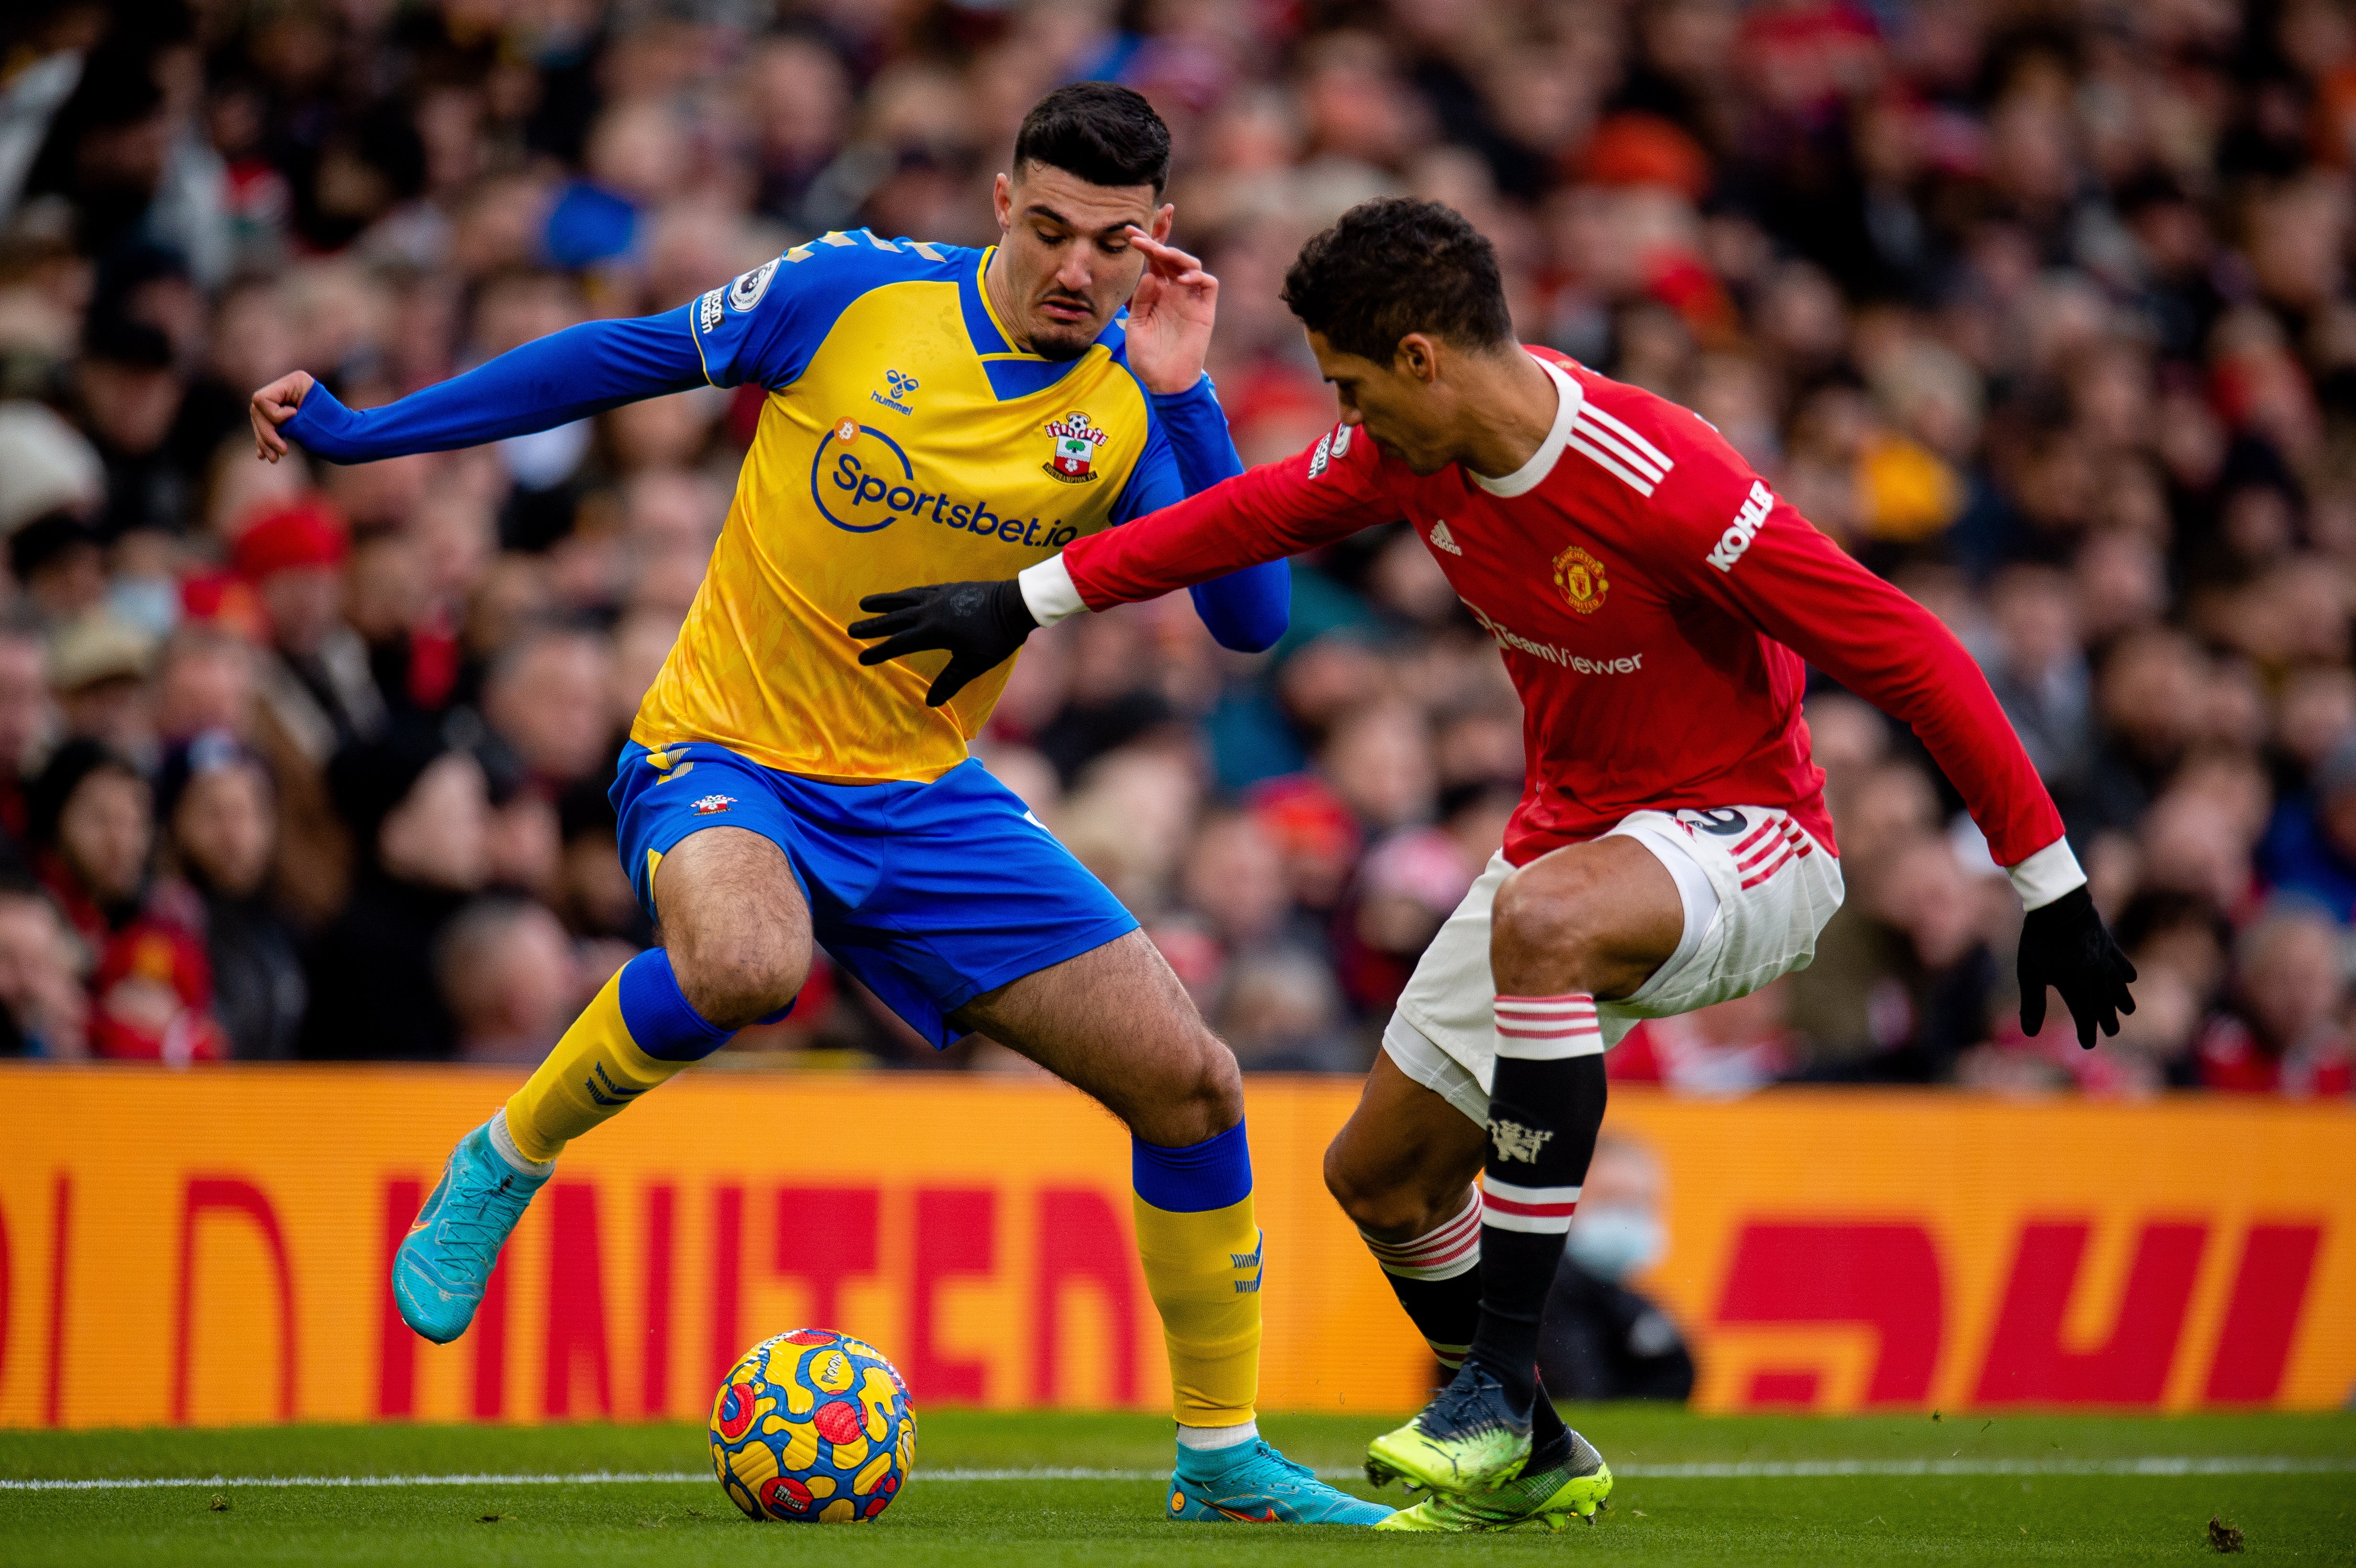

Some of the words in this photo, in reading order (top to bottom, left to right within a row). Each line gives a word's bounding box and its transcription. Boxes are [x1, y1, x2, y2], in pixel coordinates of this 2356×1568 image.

[870, 390, 914, 416] hummel
[1044, 464, 1087, 483] SOUTHAMPTON
[1087, 471, 1096, 480] FC
[832, 453, 1078, 548] Sportsbet.io
[1705, 479, 1775, 573] KOHLER
[1429, 534, 1463, 556] adidas
[1557, 551, 1601, 574] MANCHESTER
[1568, 596, 1599, 610] UNITED
[1493, 622, 1643, 675] TeamViewer
[774, 1490, 805, 1510] FLIGHT
